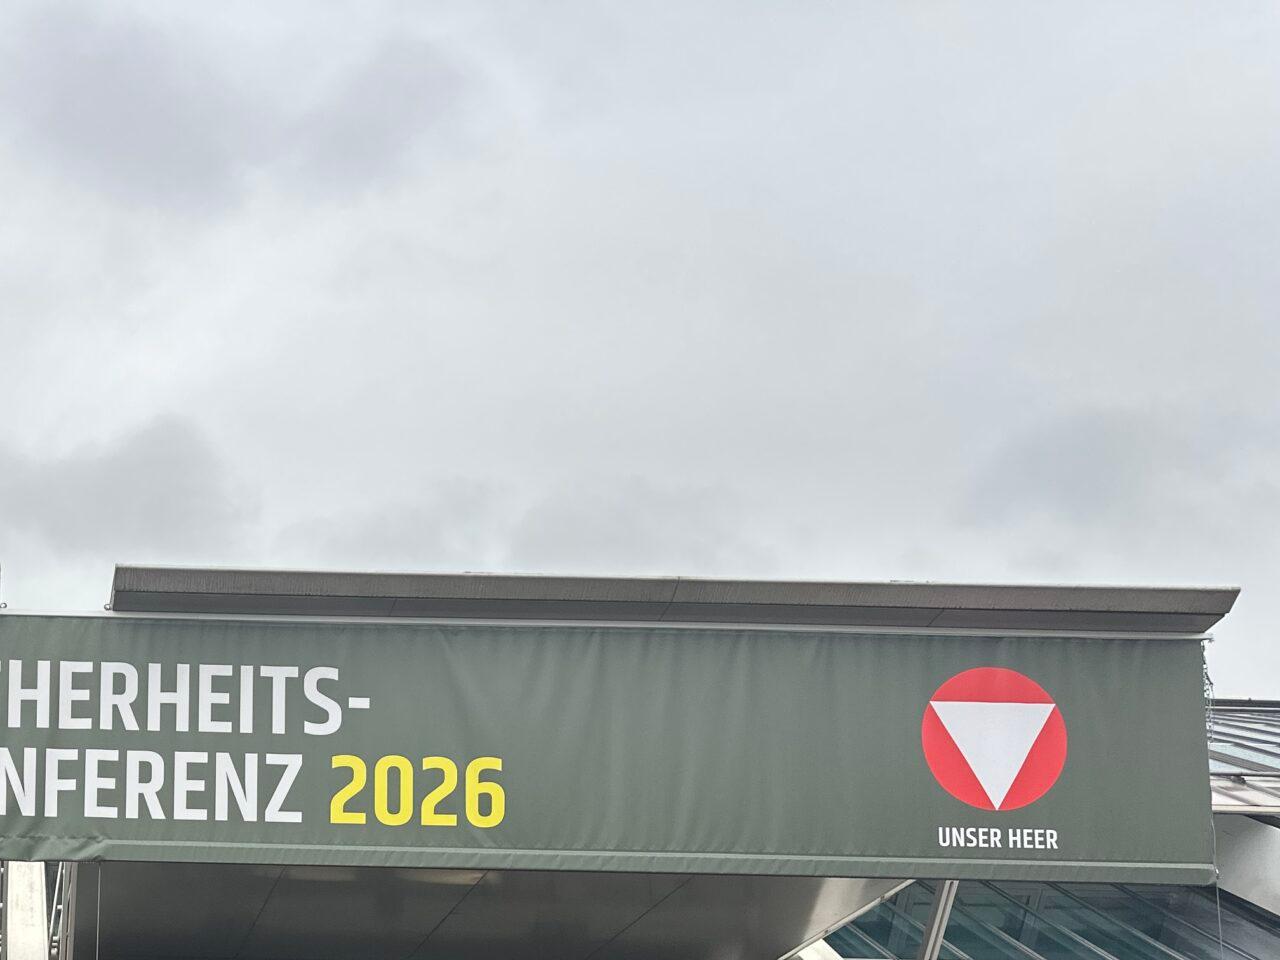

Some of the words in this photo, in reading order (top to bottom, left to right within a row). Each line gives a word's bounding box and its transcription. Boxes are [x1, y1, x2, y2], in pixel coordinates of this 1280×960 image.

[329, 754, 506, 829] 2026
[937, 825, 1003, 849] UNSER
[1007, 827, 1060, 850] HEER
